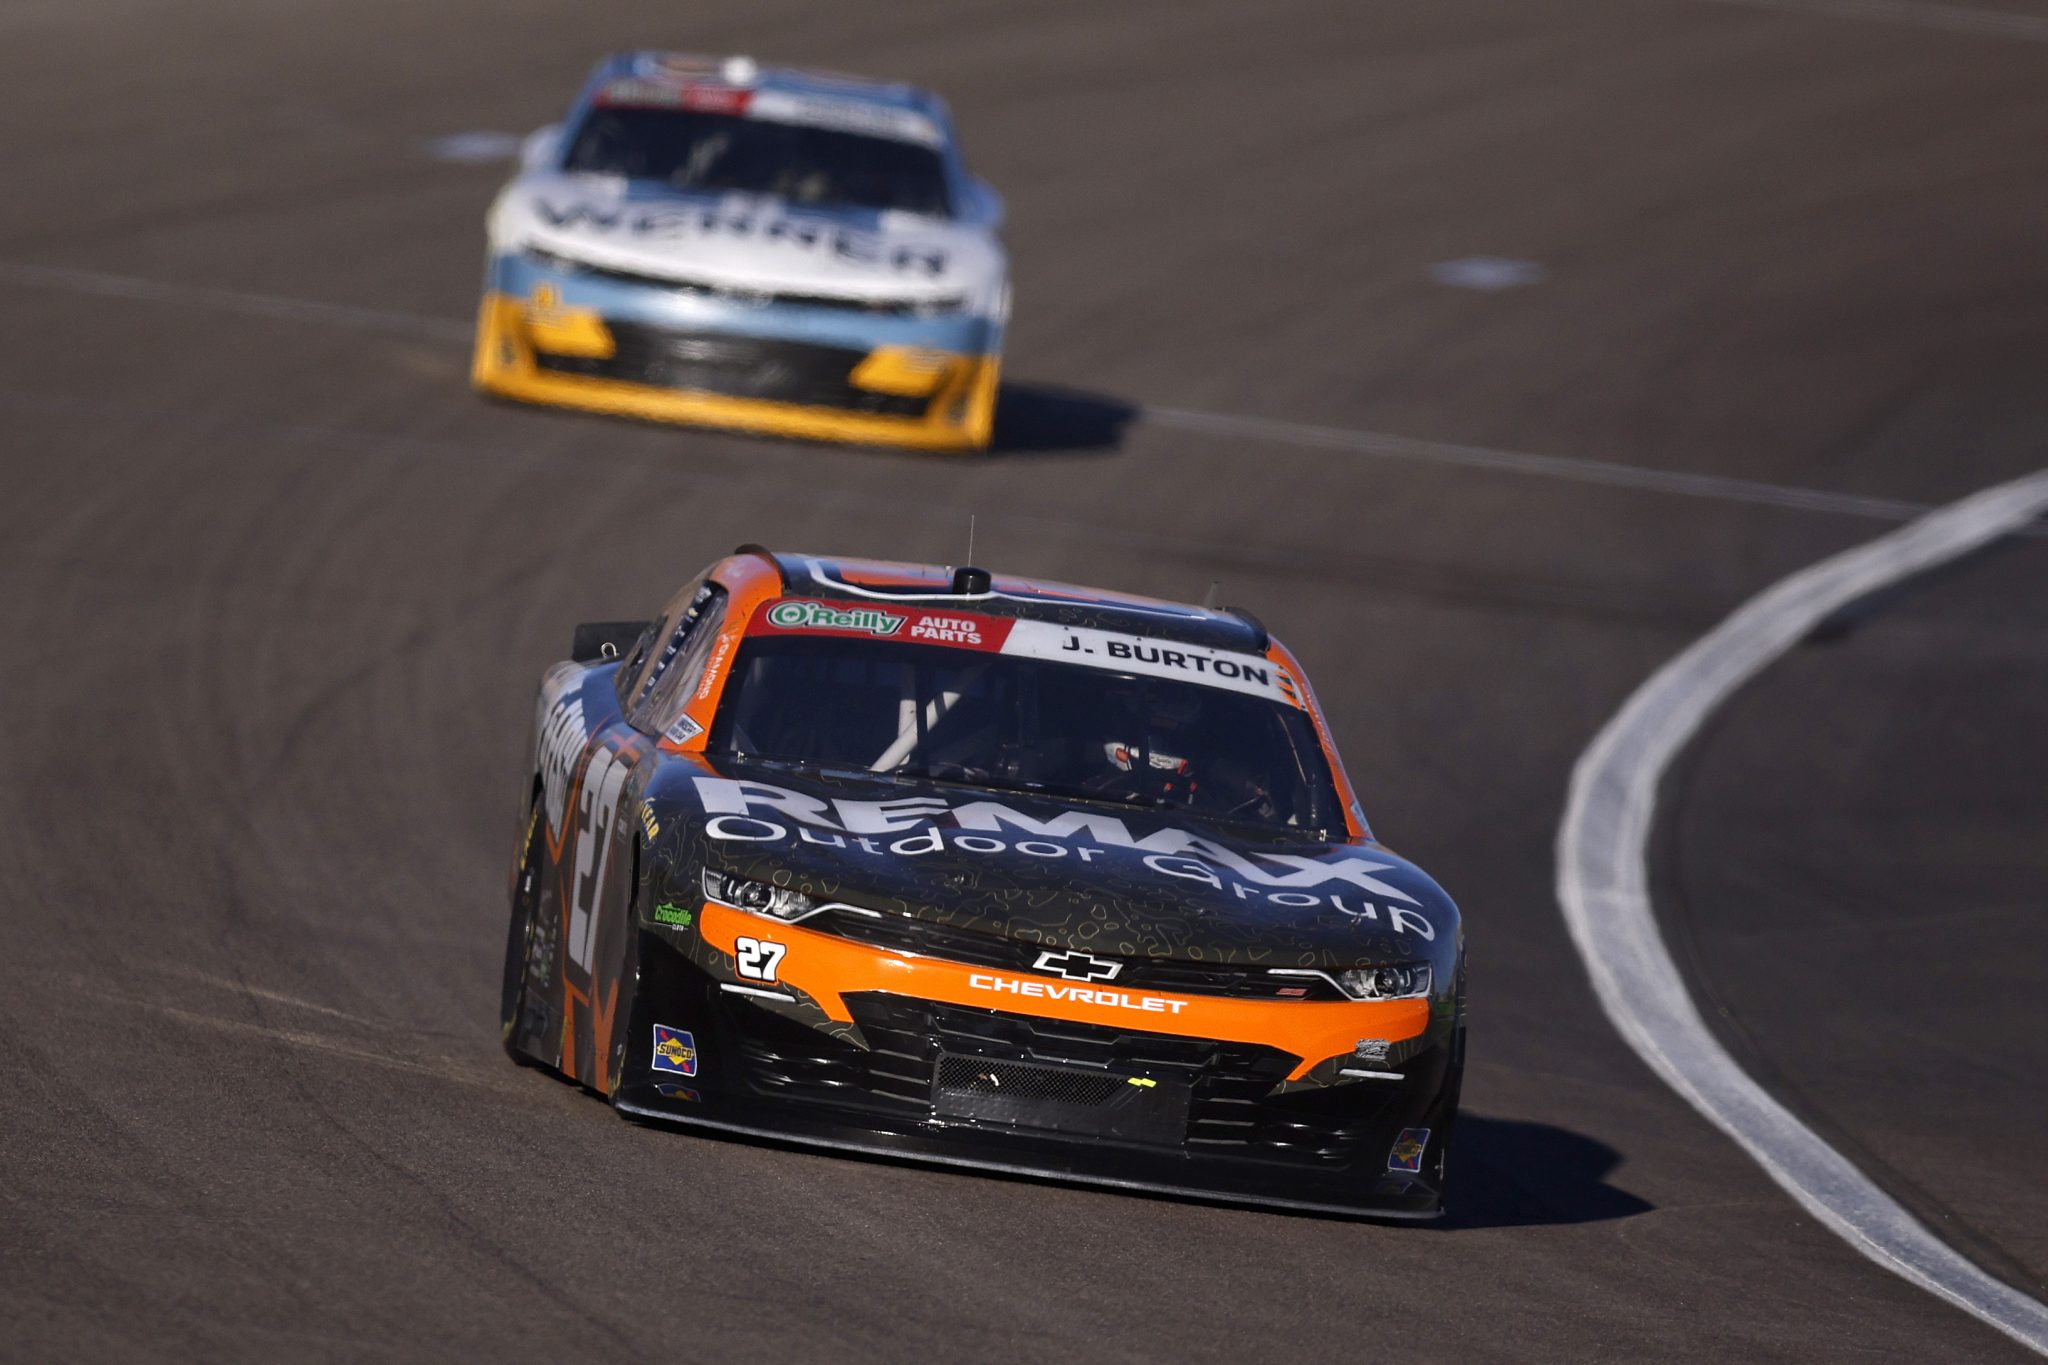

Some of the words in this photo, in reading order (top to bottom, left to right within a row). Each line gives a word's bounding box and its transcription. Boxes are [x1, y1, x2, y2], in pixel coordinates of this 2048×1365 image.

[534, 196, 949, 276] WERNER
[770, 601, 905, 636] O'Reilly
[911, 625, 982, 645] PARTS
[919, 616, 976, 633] AUTO
[1062, 635, 1094, 654] J.
[1106, 640, 1270, 686] BURTON
[705, 815, 1105, 862] Outdoor
[1142, 854, 1435, 942] Group
[655, 902, 692, 926] Crocodile
[736, 936, 787, 982] 27
[969, 973, 1189, 1014] CHEVROLET
[658, 1043, 693, 1059] SUNOCO
